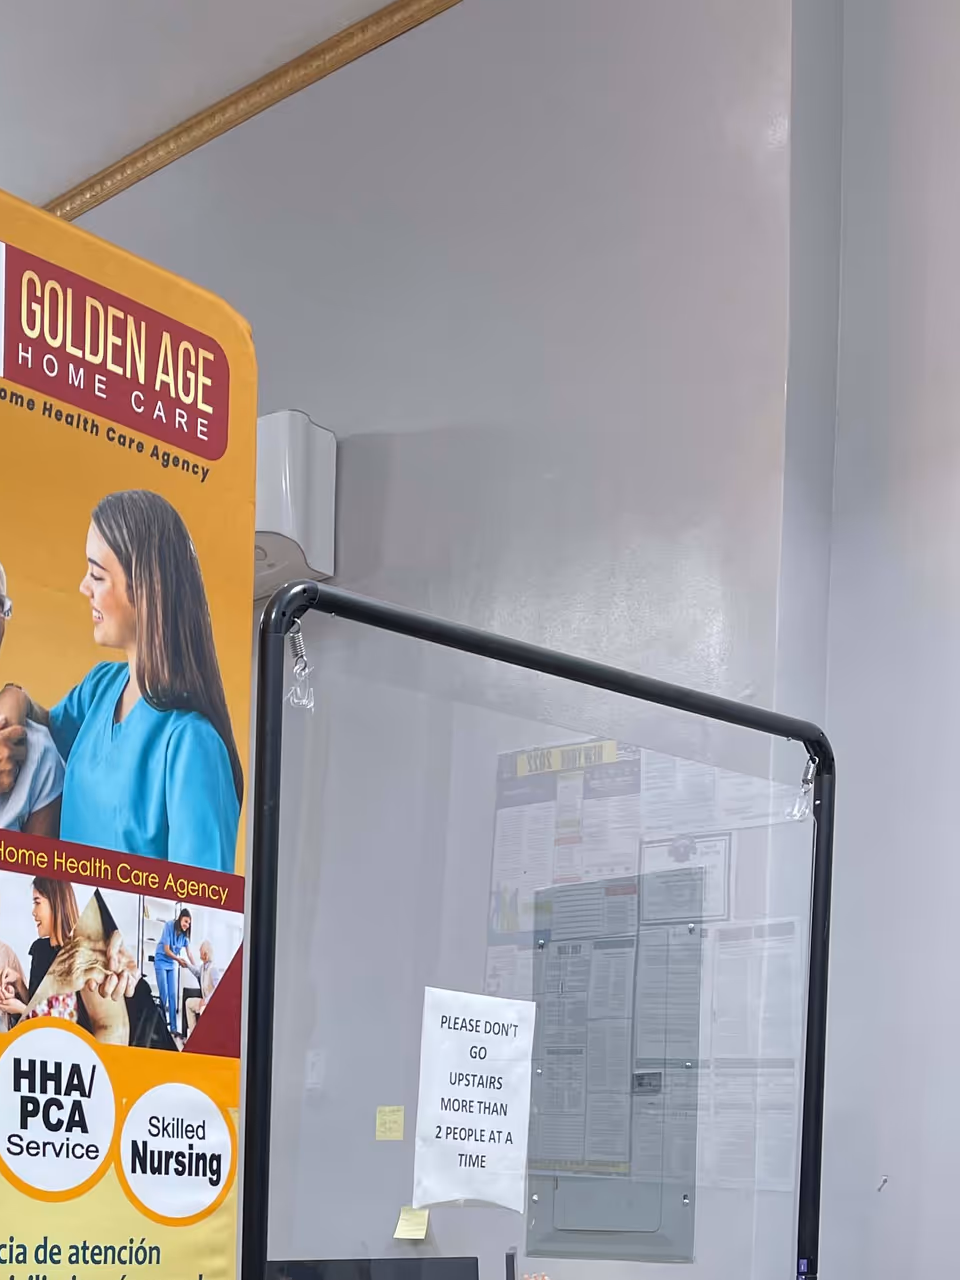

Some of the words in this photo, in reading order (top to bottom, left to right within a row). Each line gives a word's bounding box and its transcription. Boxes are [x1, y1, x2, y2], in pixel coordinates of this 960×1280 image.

[20, 270, 145, 386] GOLDEN
[154, 330, 214, 414] AGE
[18, 342, 107, 398] HOME
[131, 391, 209, 441] CARE
[42, 402, 100, 436] Health
[106, 427, 144, 454] Care
[150, 444, 210, 482] Agency
[54, 851, 111, 880] Health
[117, 863, 159, 888] Care
[164, 873, 228, 905] Agency
[440, 1015, 481, 1032] PLEASE
[484, 1020, 518, 1037] DON'T
[470, 1046, 487, 1060] GO
[13, 1058, 96, 1098] HHA/
[450, 1072, 502, 1090] UPSTAIRS
[20, 1096, 89, 1134] PCA
[440, 1098, 474, 1114] MORE
[477, 1102, 508, 1116] THAN
[148, 1116, 206, 1141] Skilled
[435, 1126, 442, 1138] 2
[446, 1126, 486, 1142] PEOPLE
[488, 1130, 502, 1144] AT
[505, 1132, 512, 1144] A
[6, 1134, 99, 1160] Service
[131, 1141, 222, 1186] Nursing
[458, 1154, 486, 1168] TIME
[34, 1236, 62, 1264] de
[68, 1238, 161, 1265] atención
